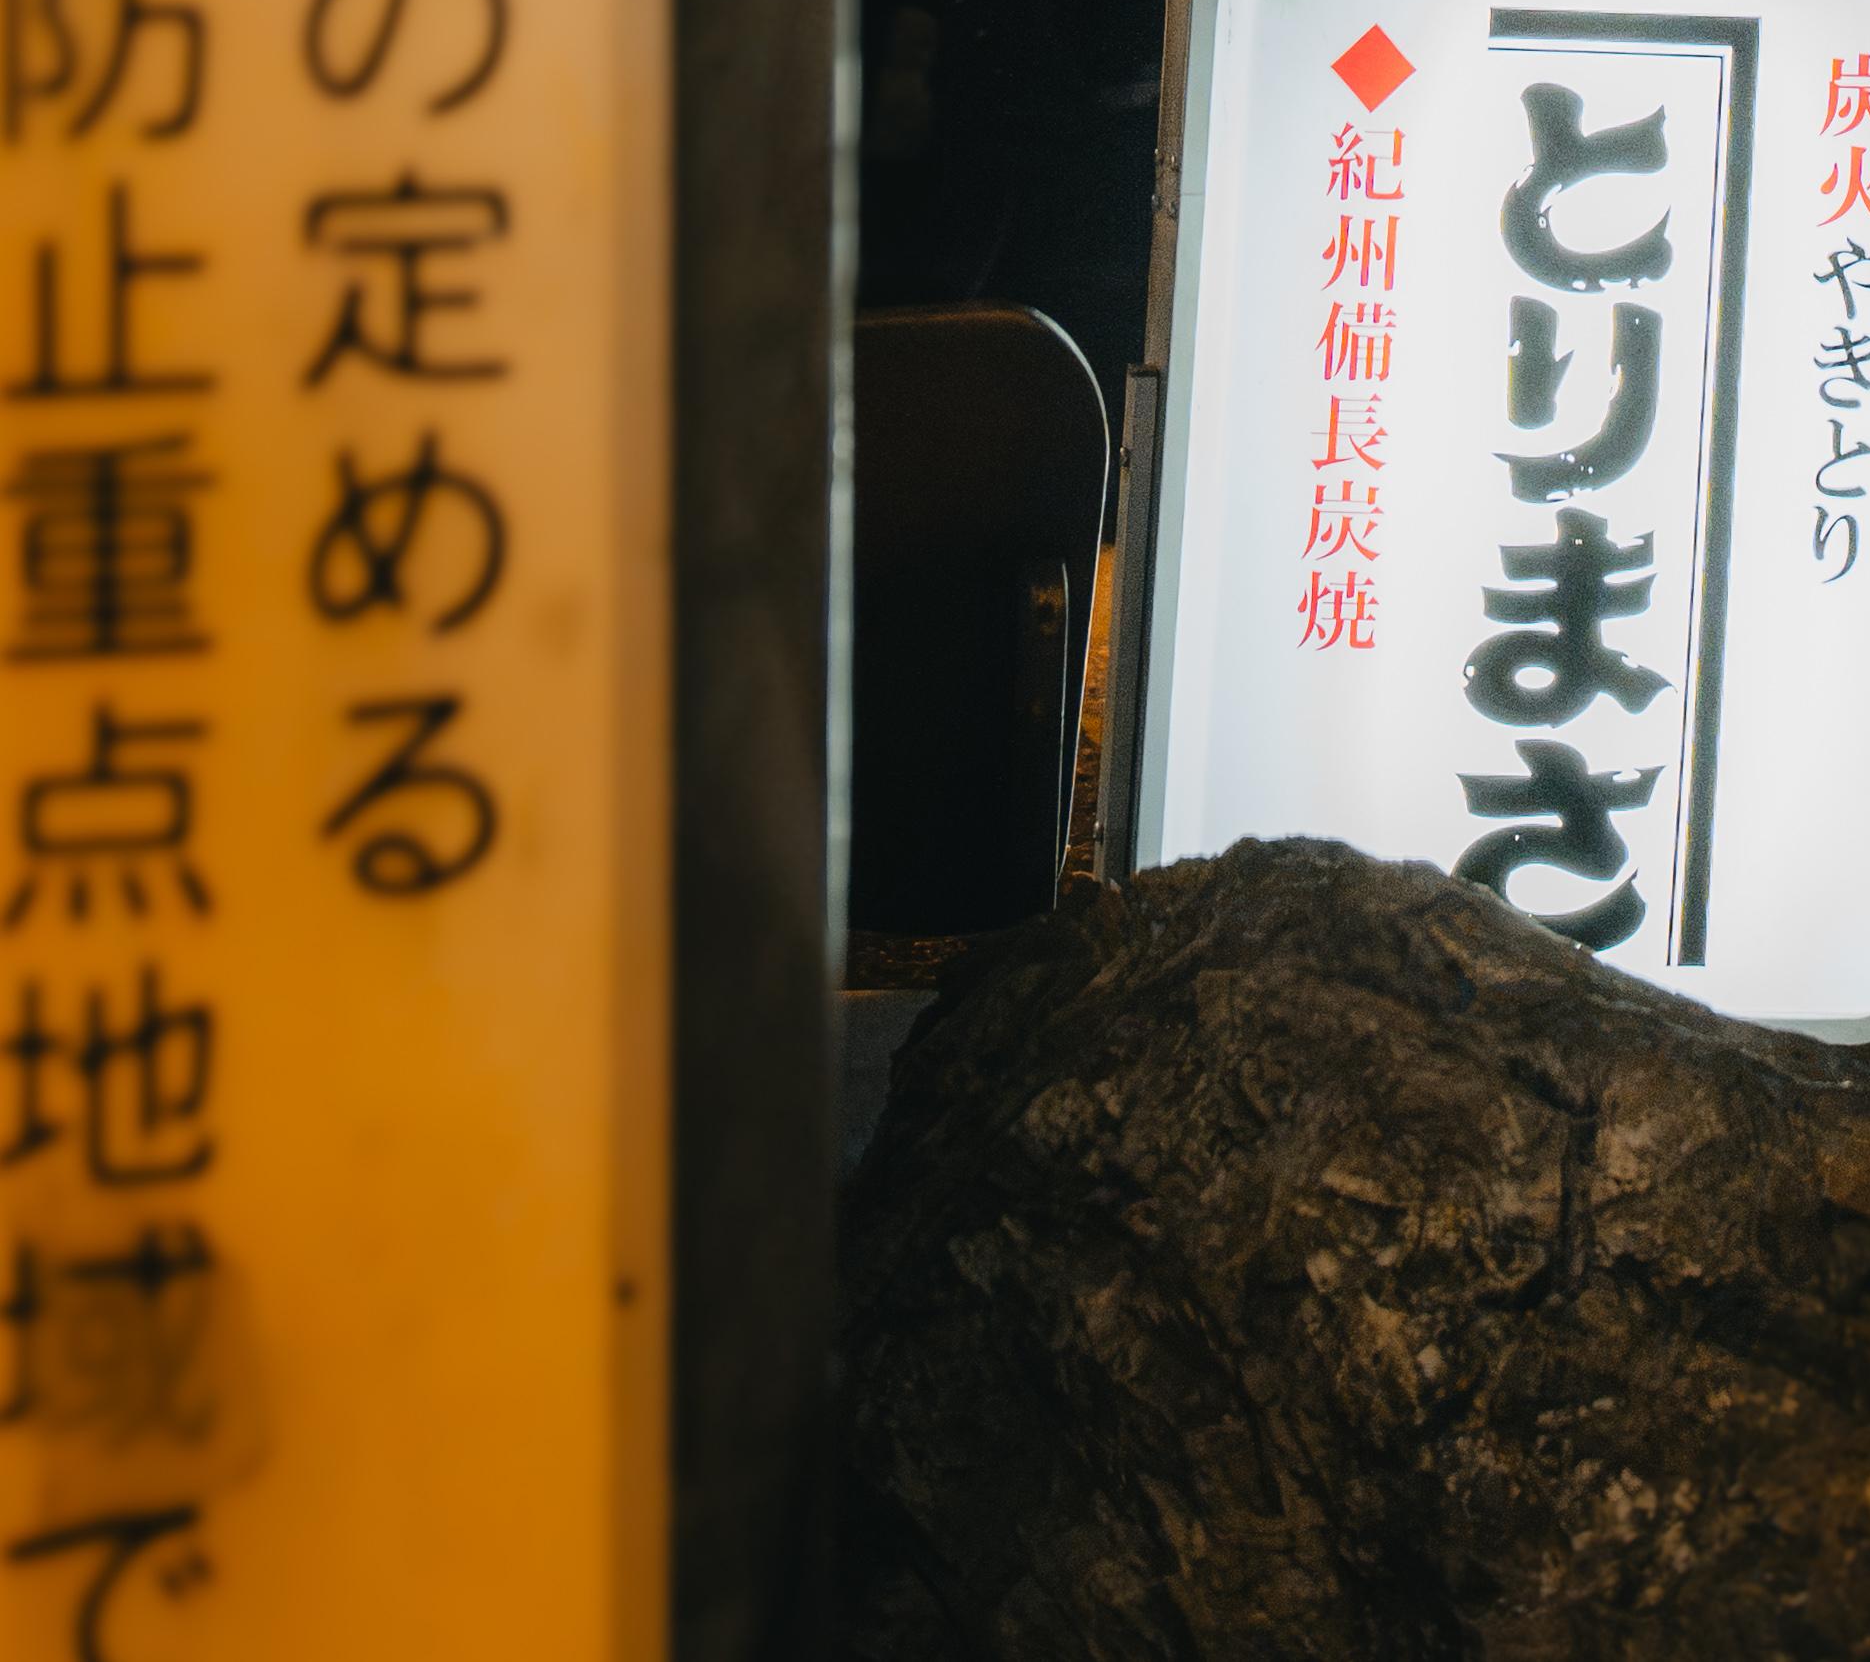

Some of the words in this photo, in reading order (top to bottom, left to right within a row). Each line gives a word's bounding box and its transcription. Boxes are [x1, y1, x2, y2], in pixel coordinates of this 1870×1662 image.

[1296, 121, 1406, 651] 紀州備長炭焼
[1453, 81, 1677, 951] とりまさ
